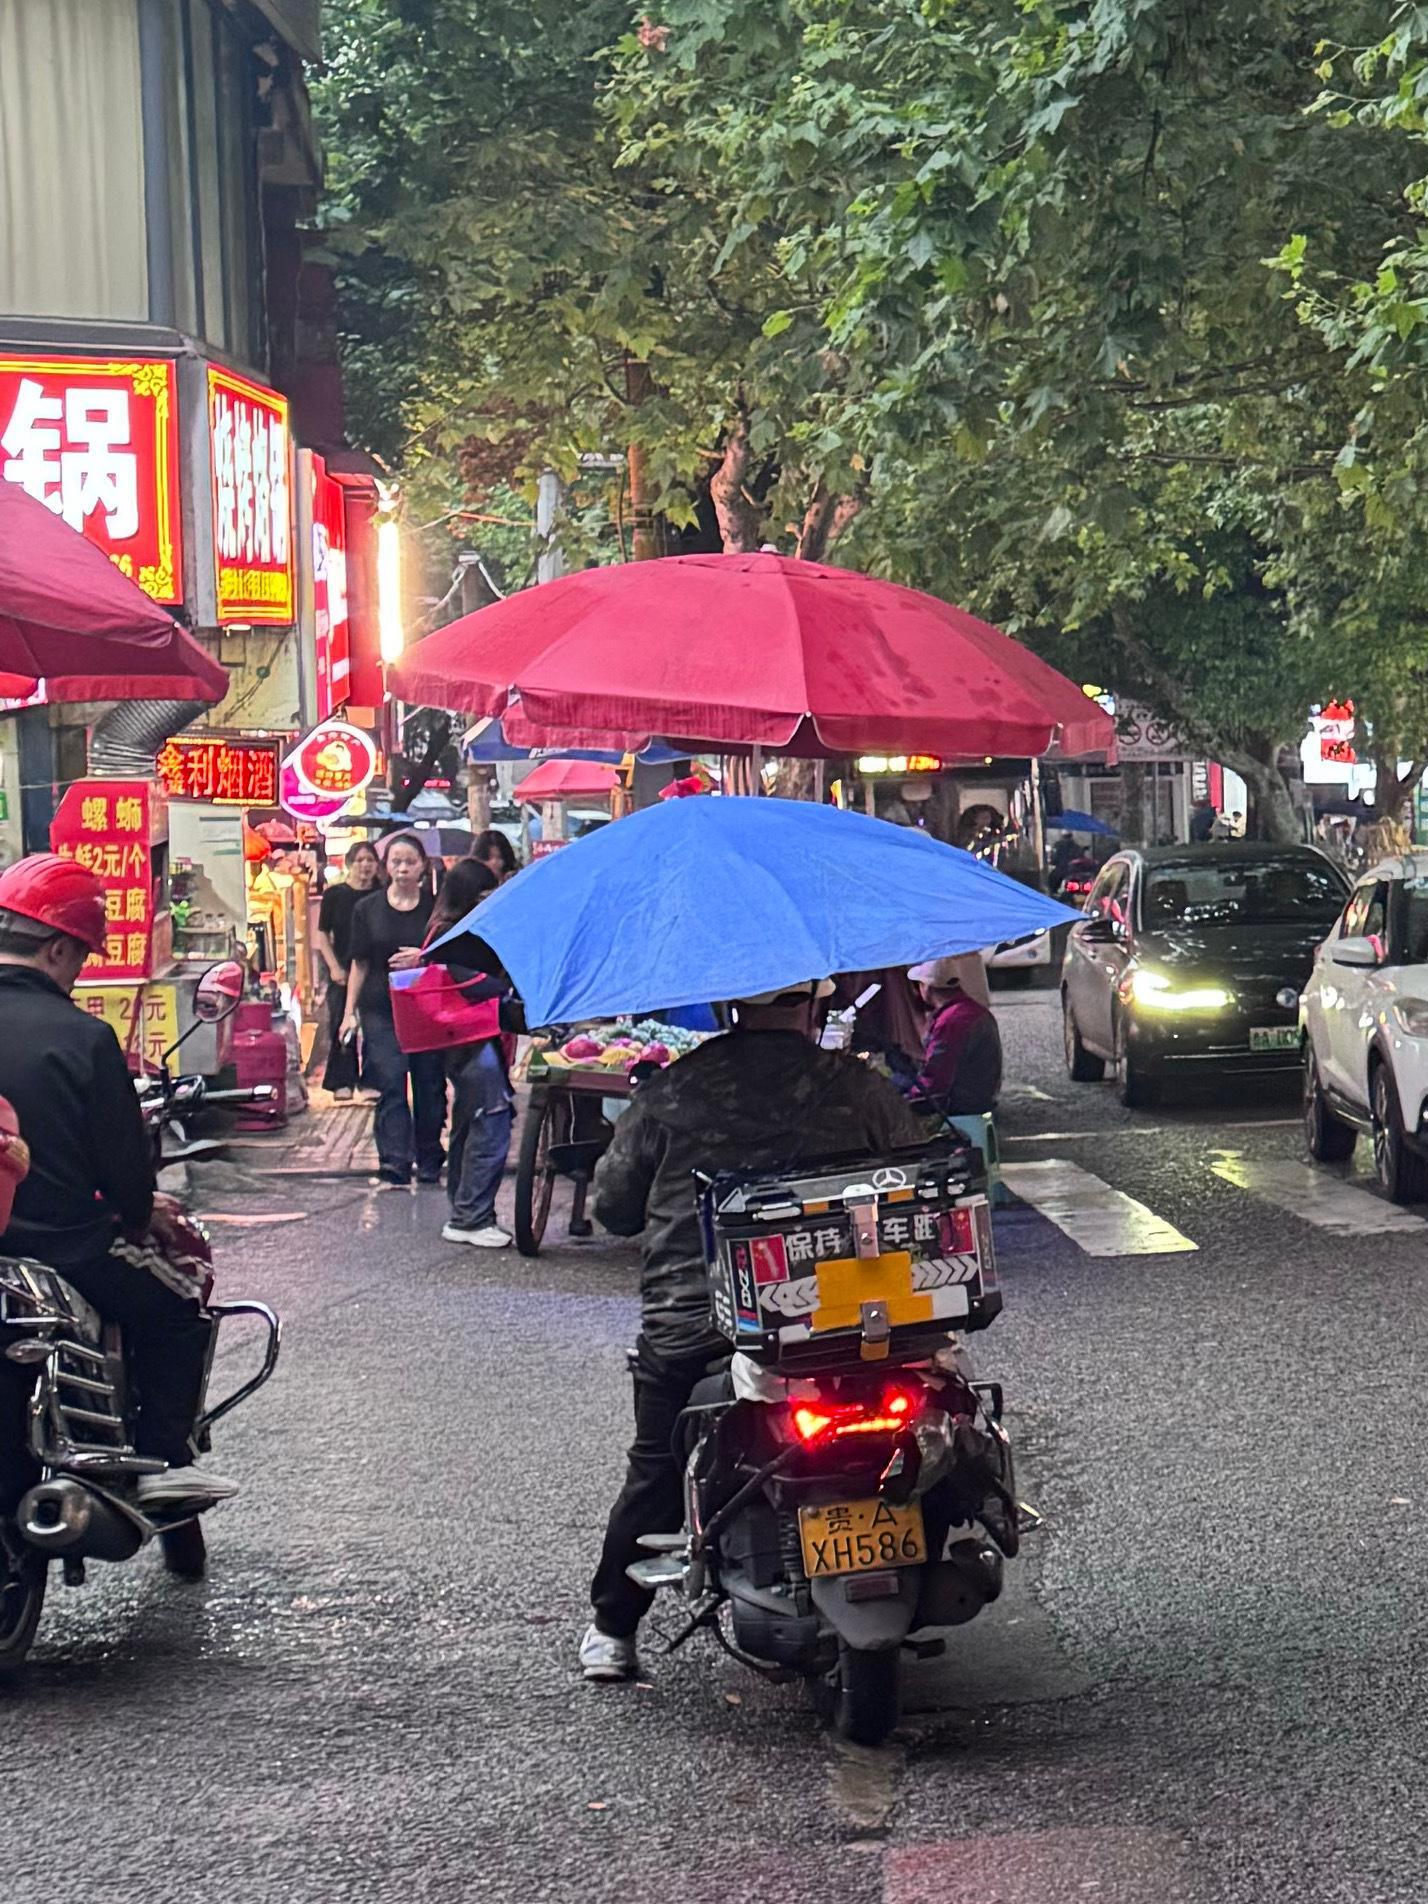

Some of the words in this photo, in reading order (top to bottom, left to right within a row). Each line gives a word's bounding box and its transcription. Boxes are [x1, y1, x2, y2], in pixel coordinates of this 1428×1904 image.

[0, 378, 139, 540] 锅
[156, 743, 276, 799] 鑫利烟酒
[785, 1227, 842, 1263] 保持
[882, 1213, 937, 1247] 车距
[811, 1527, 919, 1574] XH586
